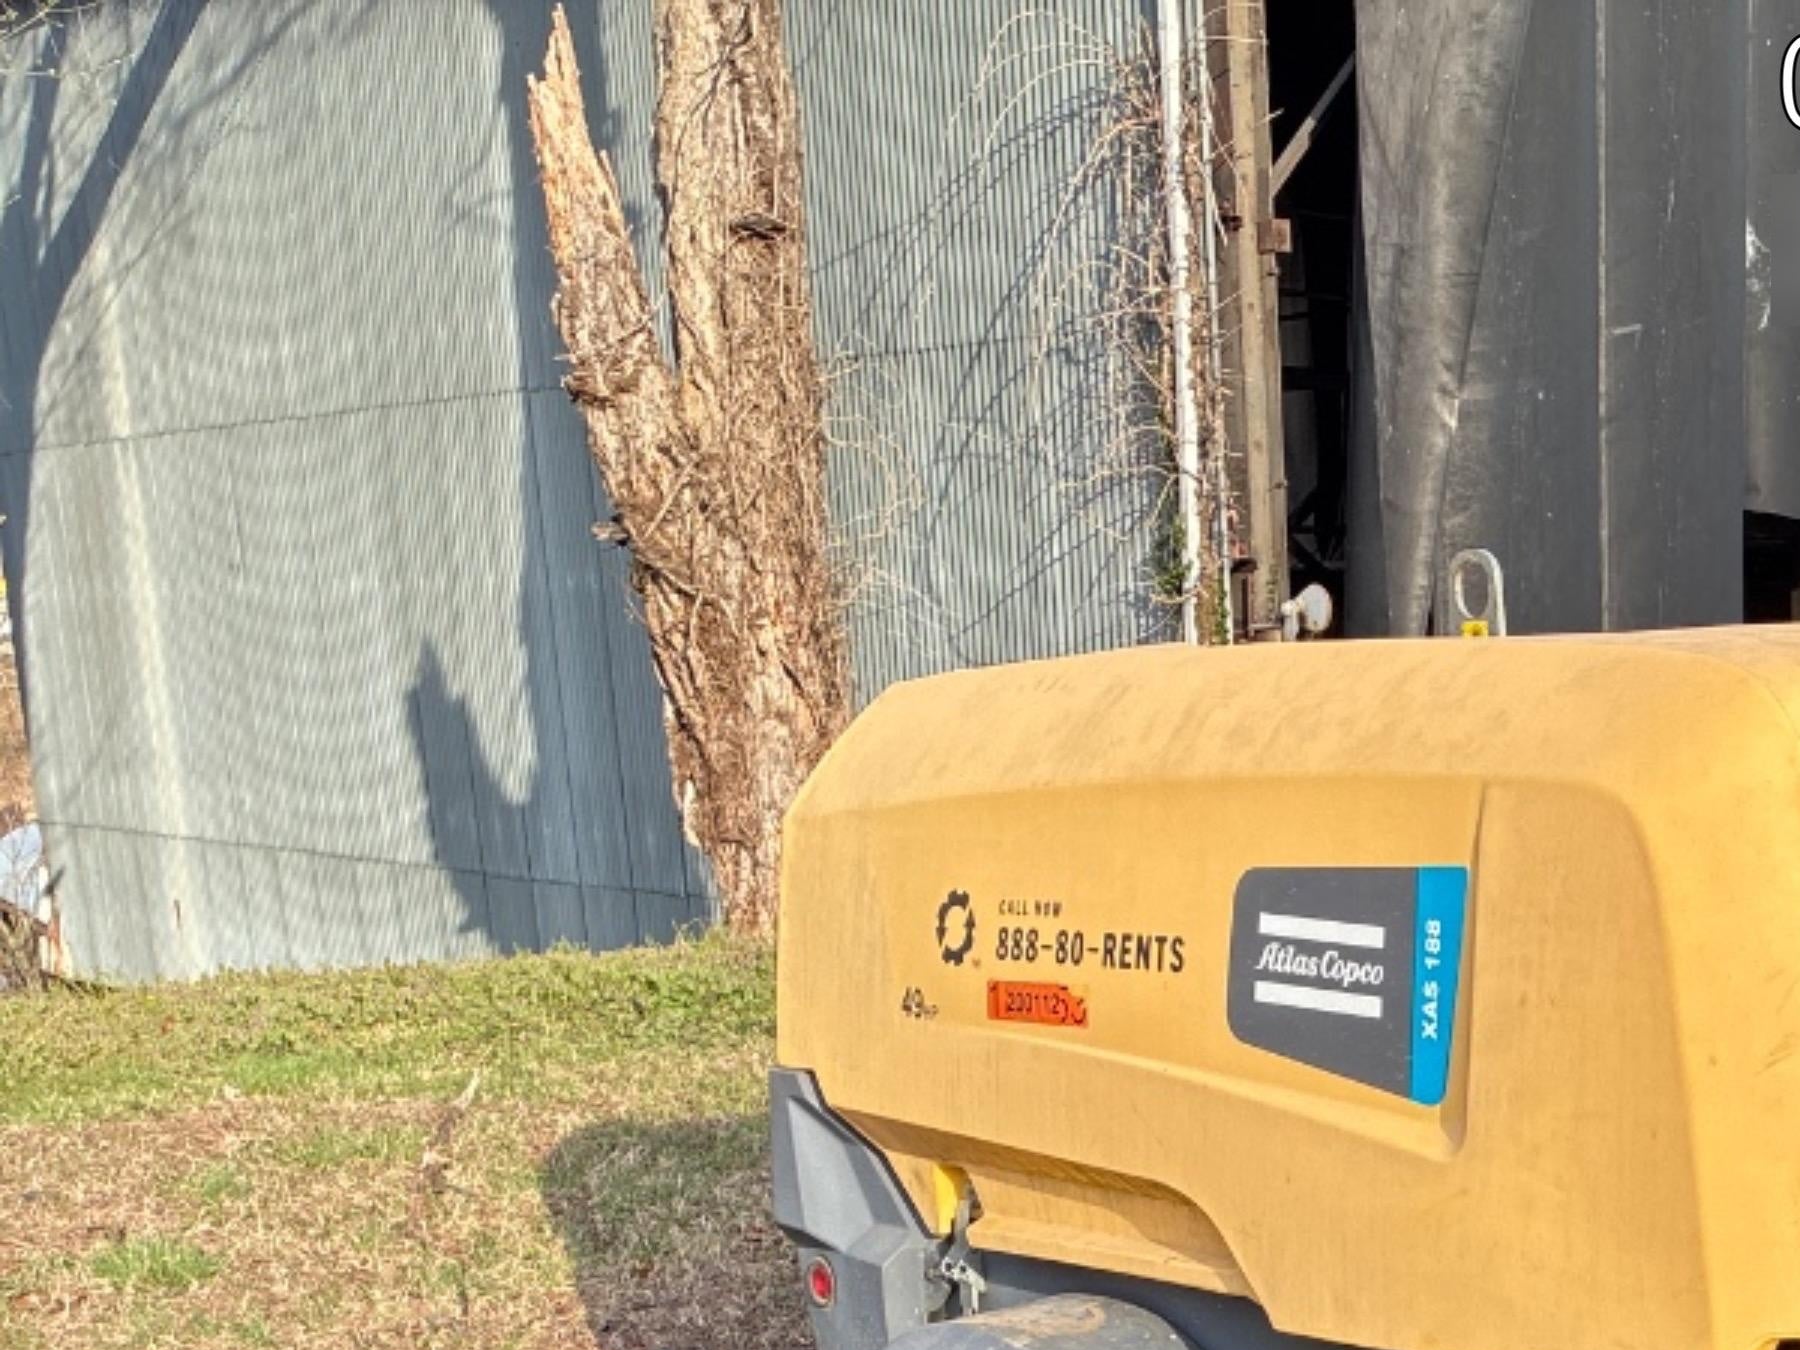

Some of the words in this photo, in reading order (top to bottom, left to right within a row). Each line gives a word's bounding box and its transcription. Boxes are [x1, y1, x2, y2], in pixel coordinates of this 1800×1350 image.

[995, 926, 1185, 973] 888-80-RENTS
[1255, 941, 1319, 977] Atlas
[1319, 950, 1385, 988] Copco
[1424, 919, 1442, 970] 188
[1421, 980, 1441, 1041] XAS
